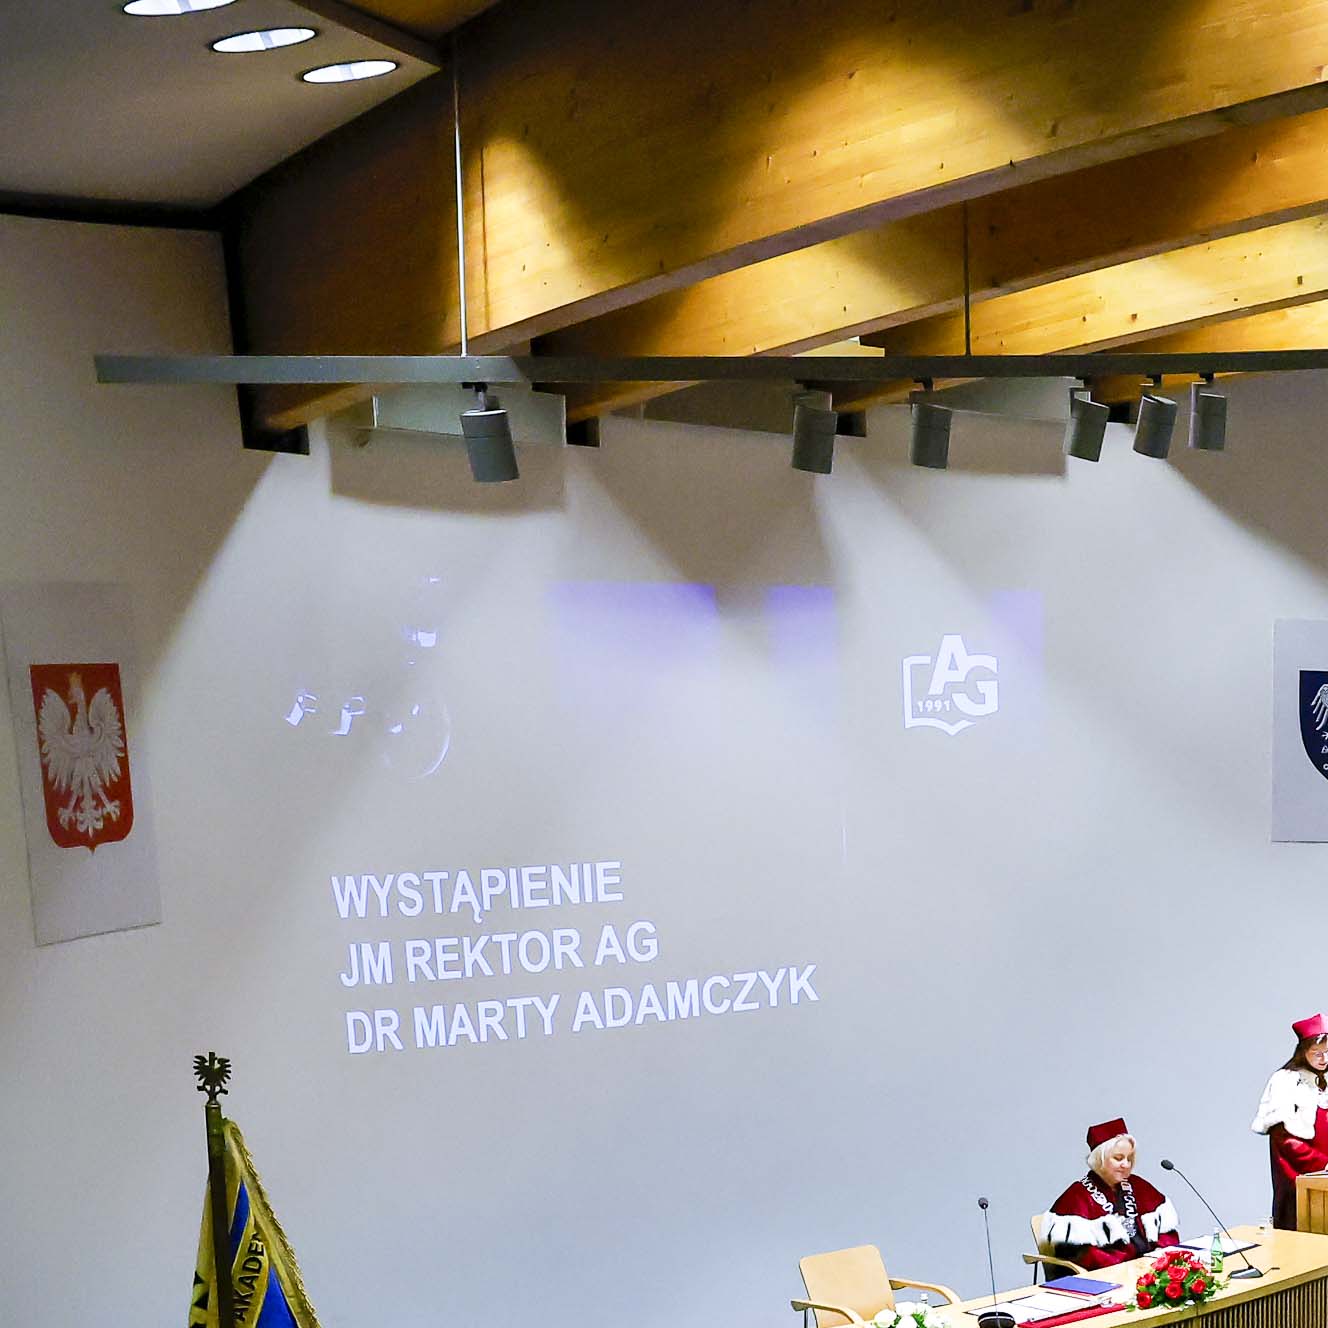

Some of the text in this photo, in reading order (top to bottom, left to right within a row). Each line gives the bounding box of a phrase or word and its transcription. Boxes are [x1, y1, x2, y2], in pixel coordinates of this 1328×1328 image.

[917, 699, 951, 713] 1991
[927, 634, 999, 717] AG
[330, 860, 624, 924] WYSTĄPIENIE
[340, 920, 658, 988] JM REKTOR AG
[346, 964, 820, 1054] DR MARTY ADAMCZYK
